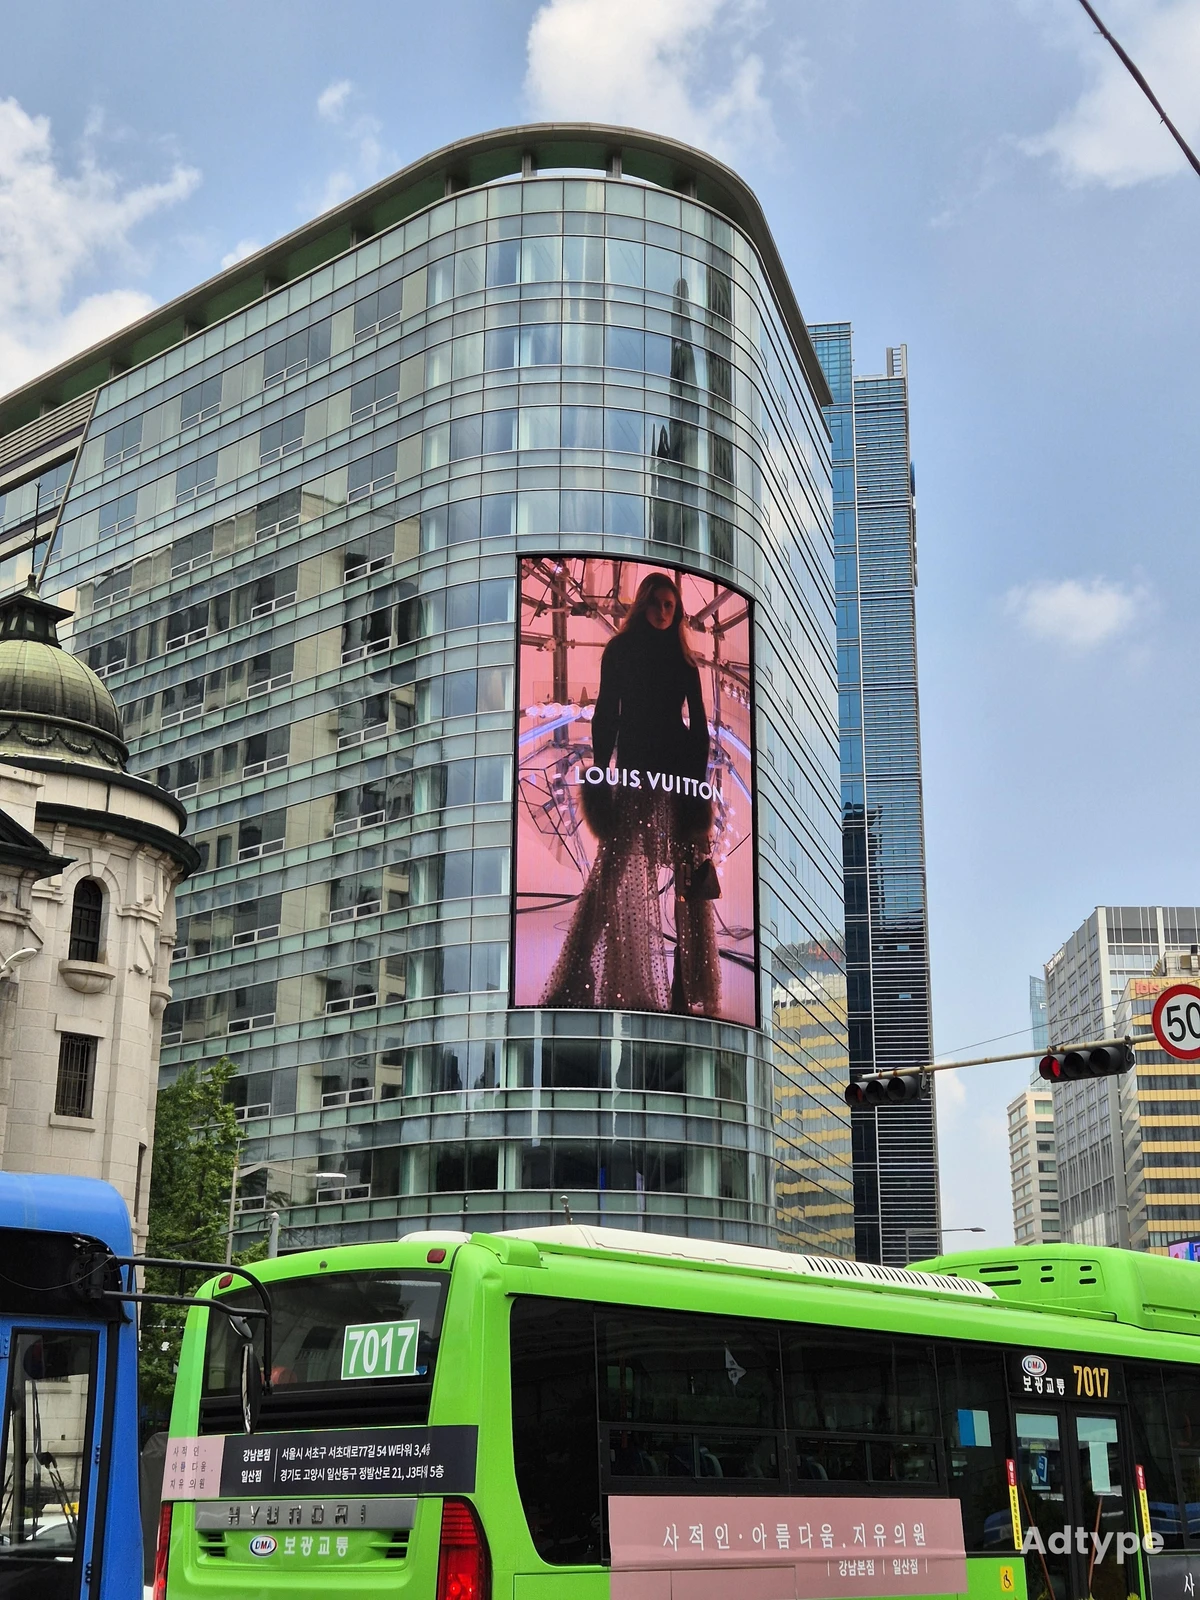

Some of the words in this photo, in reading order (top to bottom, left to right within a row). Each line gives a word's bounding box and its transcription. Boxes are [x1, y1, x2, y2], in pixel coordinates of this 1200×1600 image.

[574, 765, 640, 787] LOUIS
[646, 770, 725, 803] VUITTON
[1135, 980, 1160, 994] ibis
[1166, 1002, 1200, 1042] 50
[348, 1326, 415, 1375] 7017
[1023, 1375, 1065, 1396] 보광교통
[1073, 1365, 1109, 1398] 7017
[242, 1448, 271, 1462] 강남본점
[281, 1447, 303, 1460] 서울시
[304, 1446, 327, 1459] 서초구
[328, 1444, 376, 1459] 서초대로77길
[376, 1445, 387, 1457] 54
[388, 1443, 413, 1457] W타워
[241, 1469, 262, 1483] 일산점
[280, 1468, 301, 1482] 경기도
[302, 1467, 325, 1481] 고양시
[326, 1467, 357, 1481] 일산동구
[359, 1466, 391, 1480] 정발산로
[429, 1464, 444, 1478] 5층
[228, 1504, 366, 1526] HYUNDAI
[284, 1536, 348, 1557] 보광교통
[838, 1558, 875, 1576] 강남본점
[892, 1558, 919, 1575] 일산점
